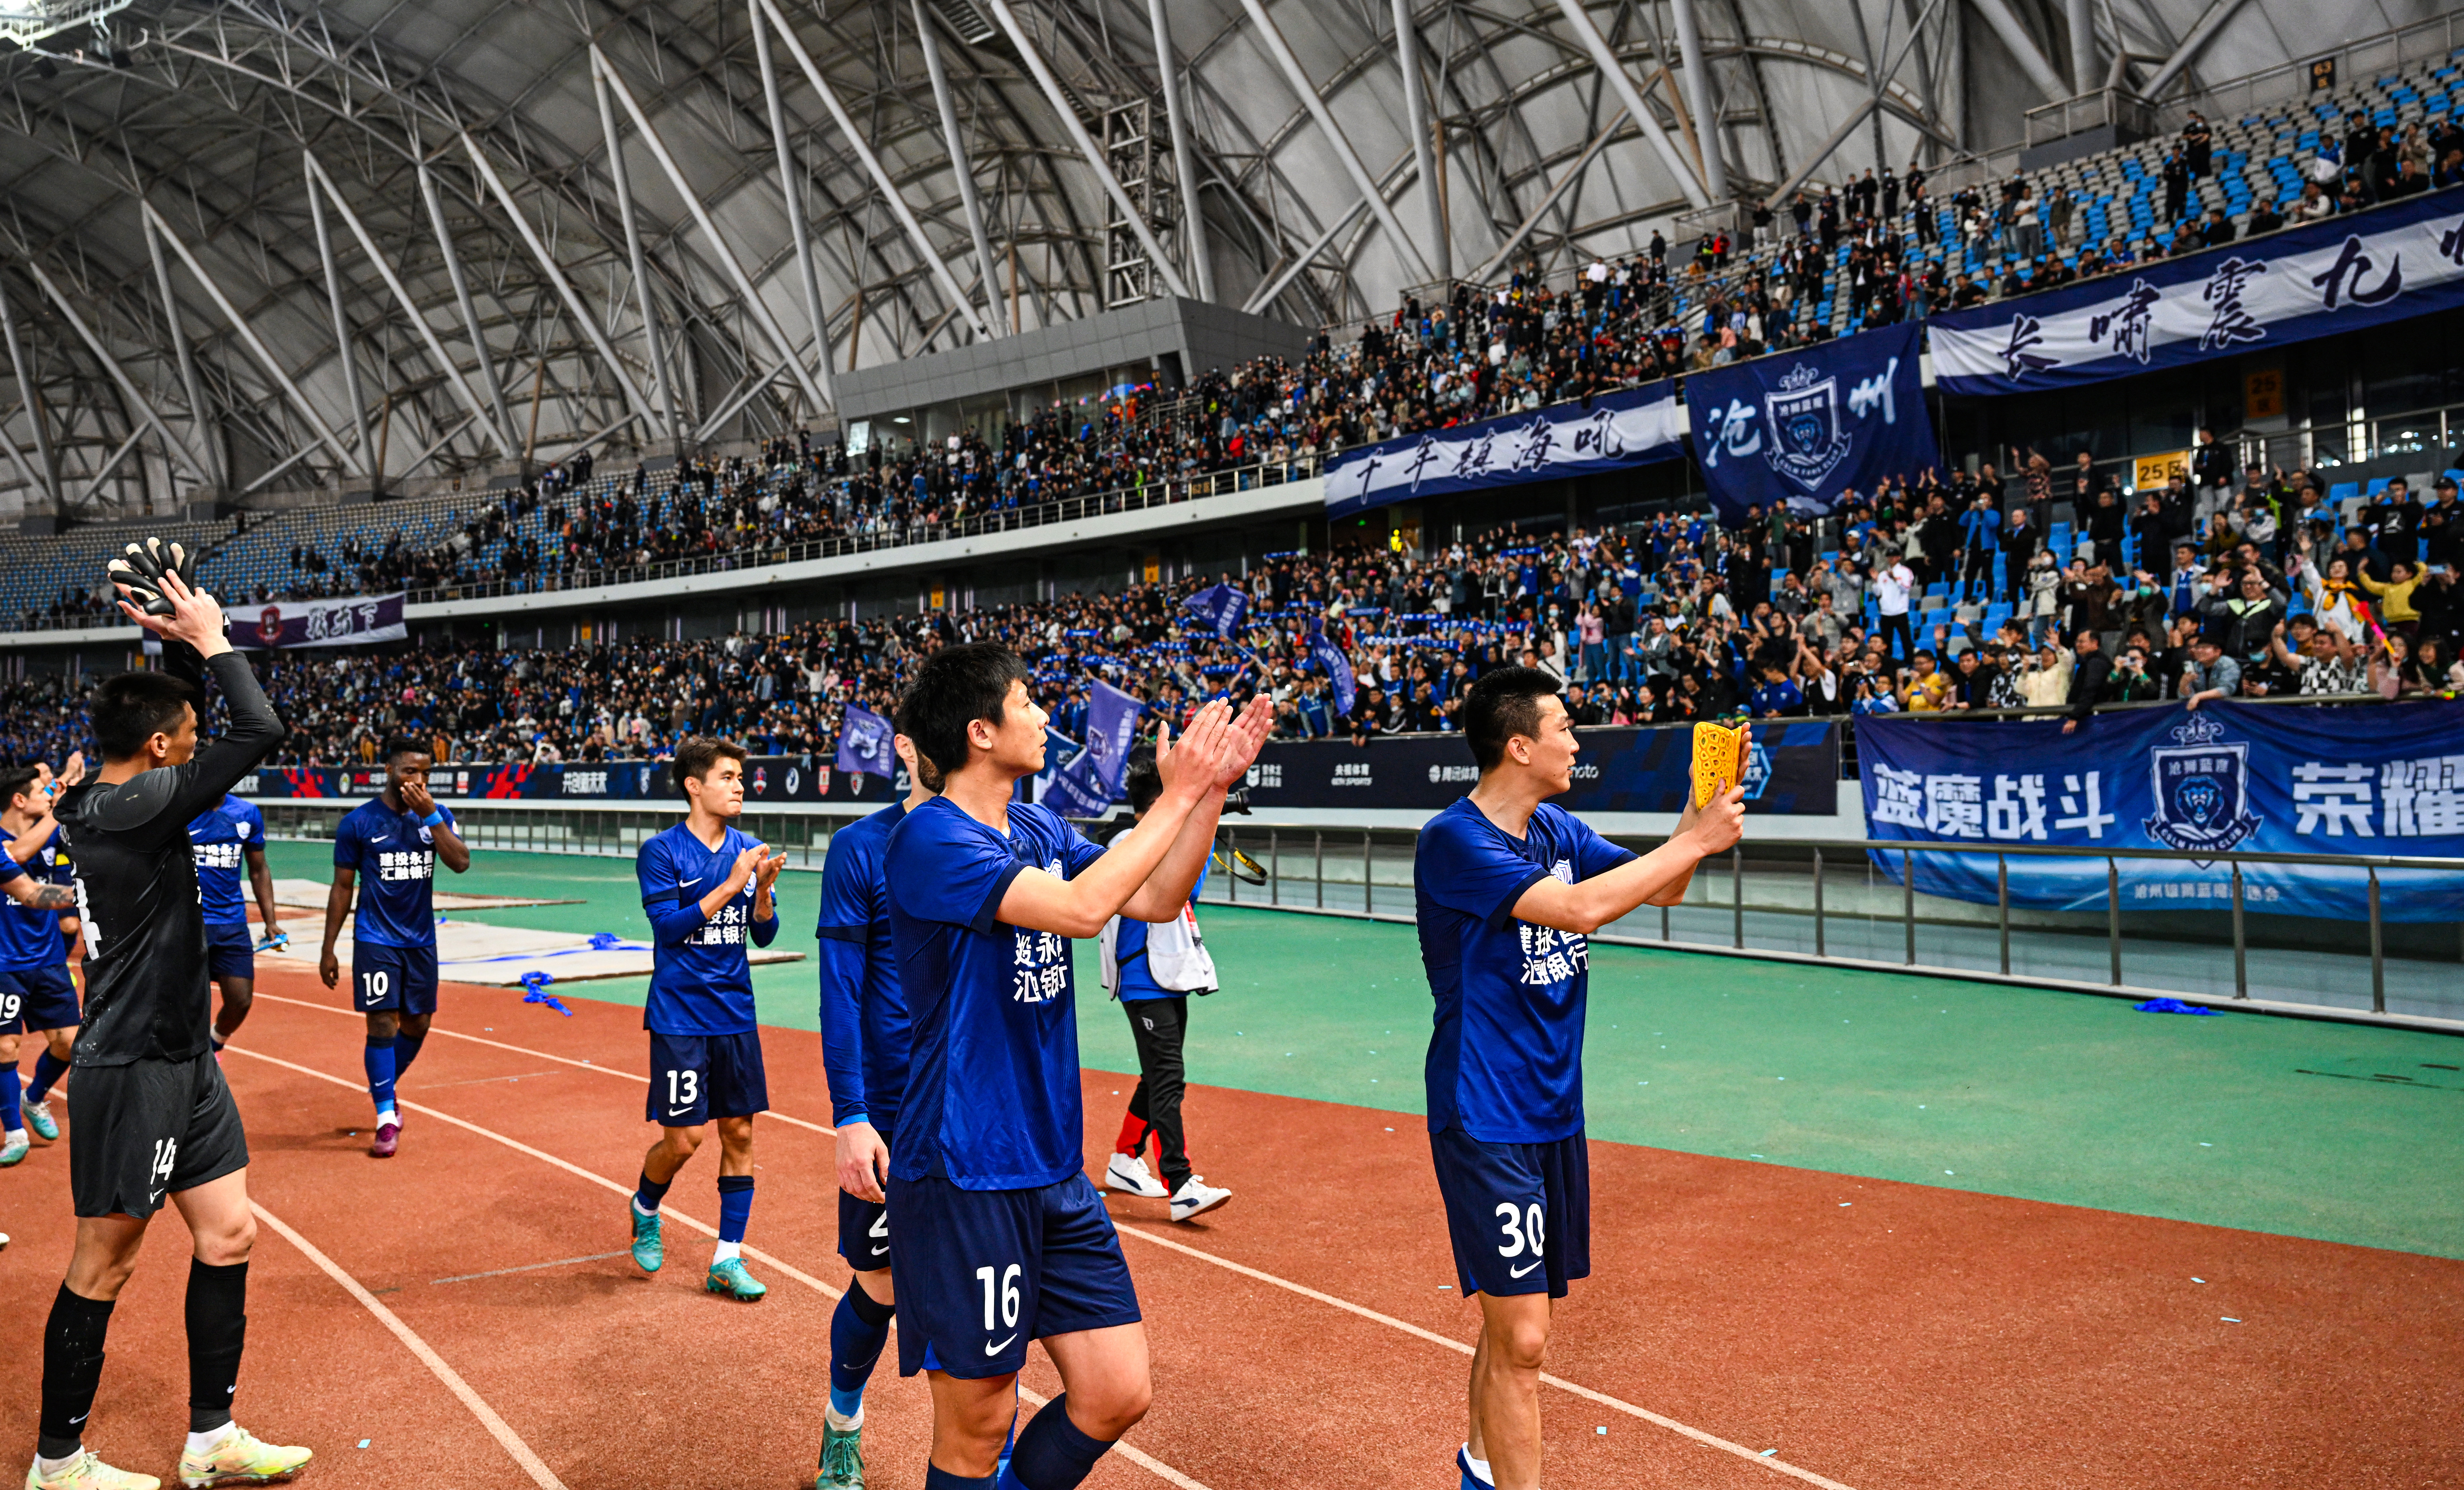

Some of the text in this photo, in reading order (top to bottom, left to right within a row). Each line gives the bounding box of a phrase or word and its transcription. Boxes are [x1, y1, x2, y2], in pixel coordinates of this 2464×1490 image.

[1871, 763, 2115, 841] 蓝魔战斗
[2292, 755, 2464, 838] 荣耀
[363, 971, 388, 997] 10
[667, 1070, 698, 1104] 13
[150, 1137, 176, 1185] 14
[1495, 1202, 1544, 1258] 30
[976, 1264, 1021, 1330] 16
